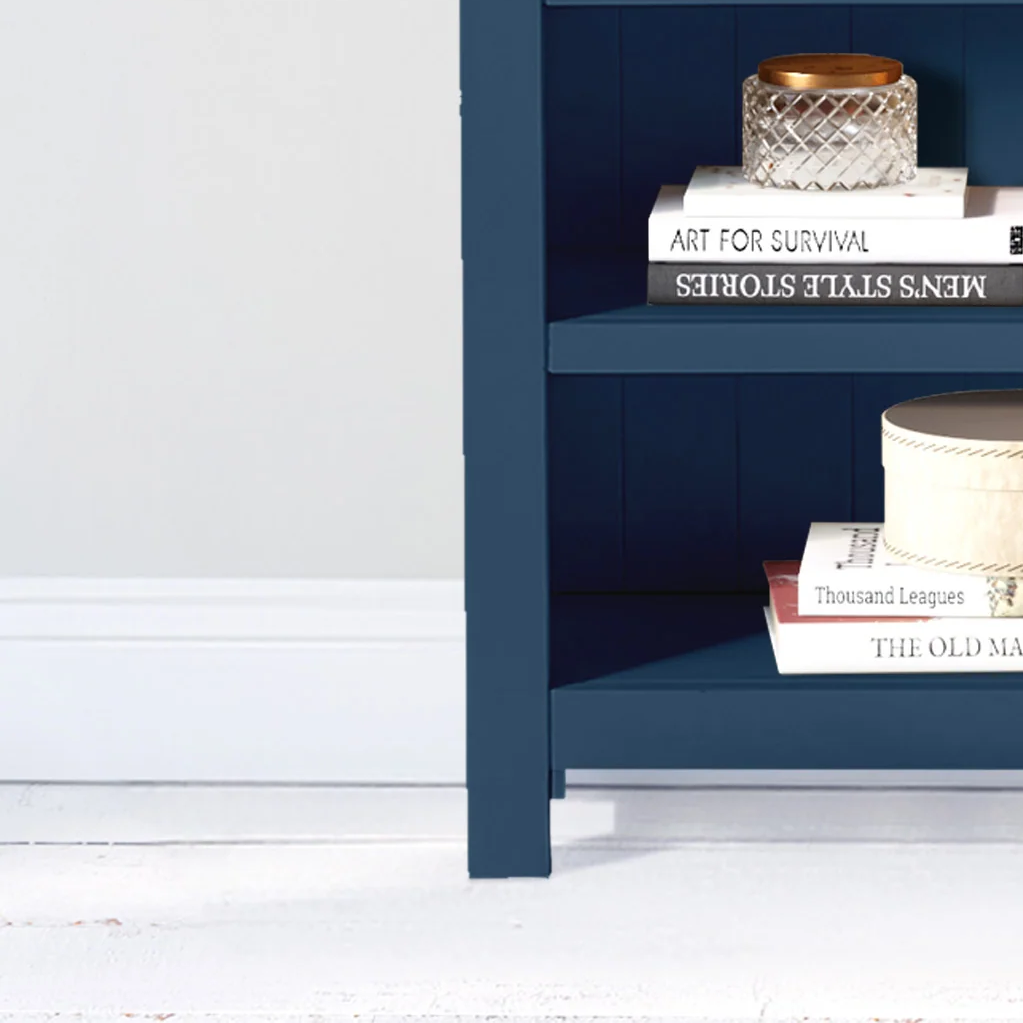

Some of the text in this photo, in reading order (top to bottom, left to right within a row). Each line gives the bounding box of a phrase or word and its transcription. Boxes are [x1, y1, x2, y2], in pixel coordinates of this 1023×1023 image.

[670, 228, 869, 253] ART FOR SURVIVAL
[676, 273, 987, 299] MEN'S STYLE STORIES
[815, 585, 965, 609] Thousand Leagues
[871, 637, 922, 658] THE
[928, 636, 981, 658] OLD
